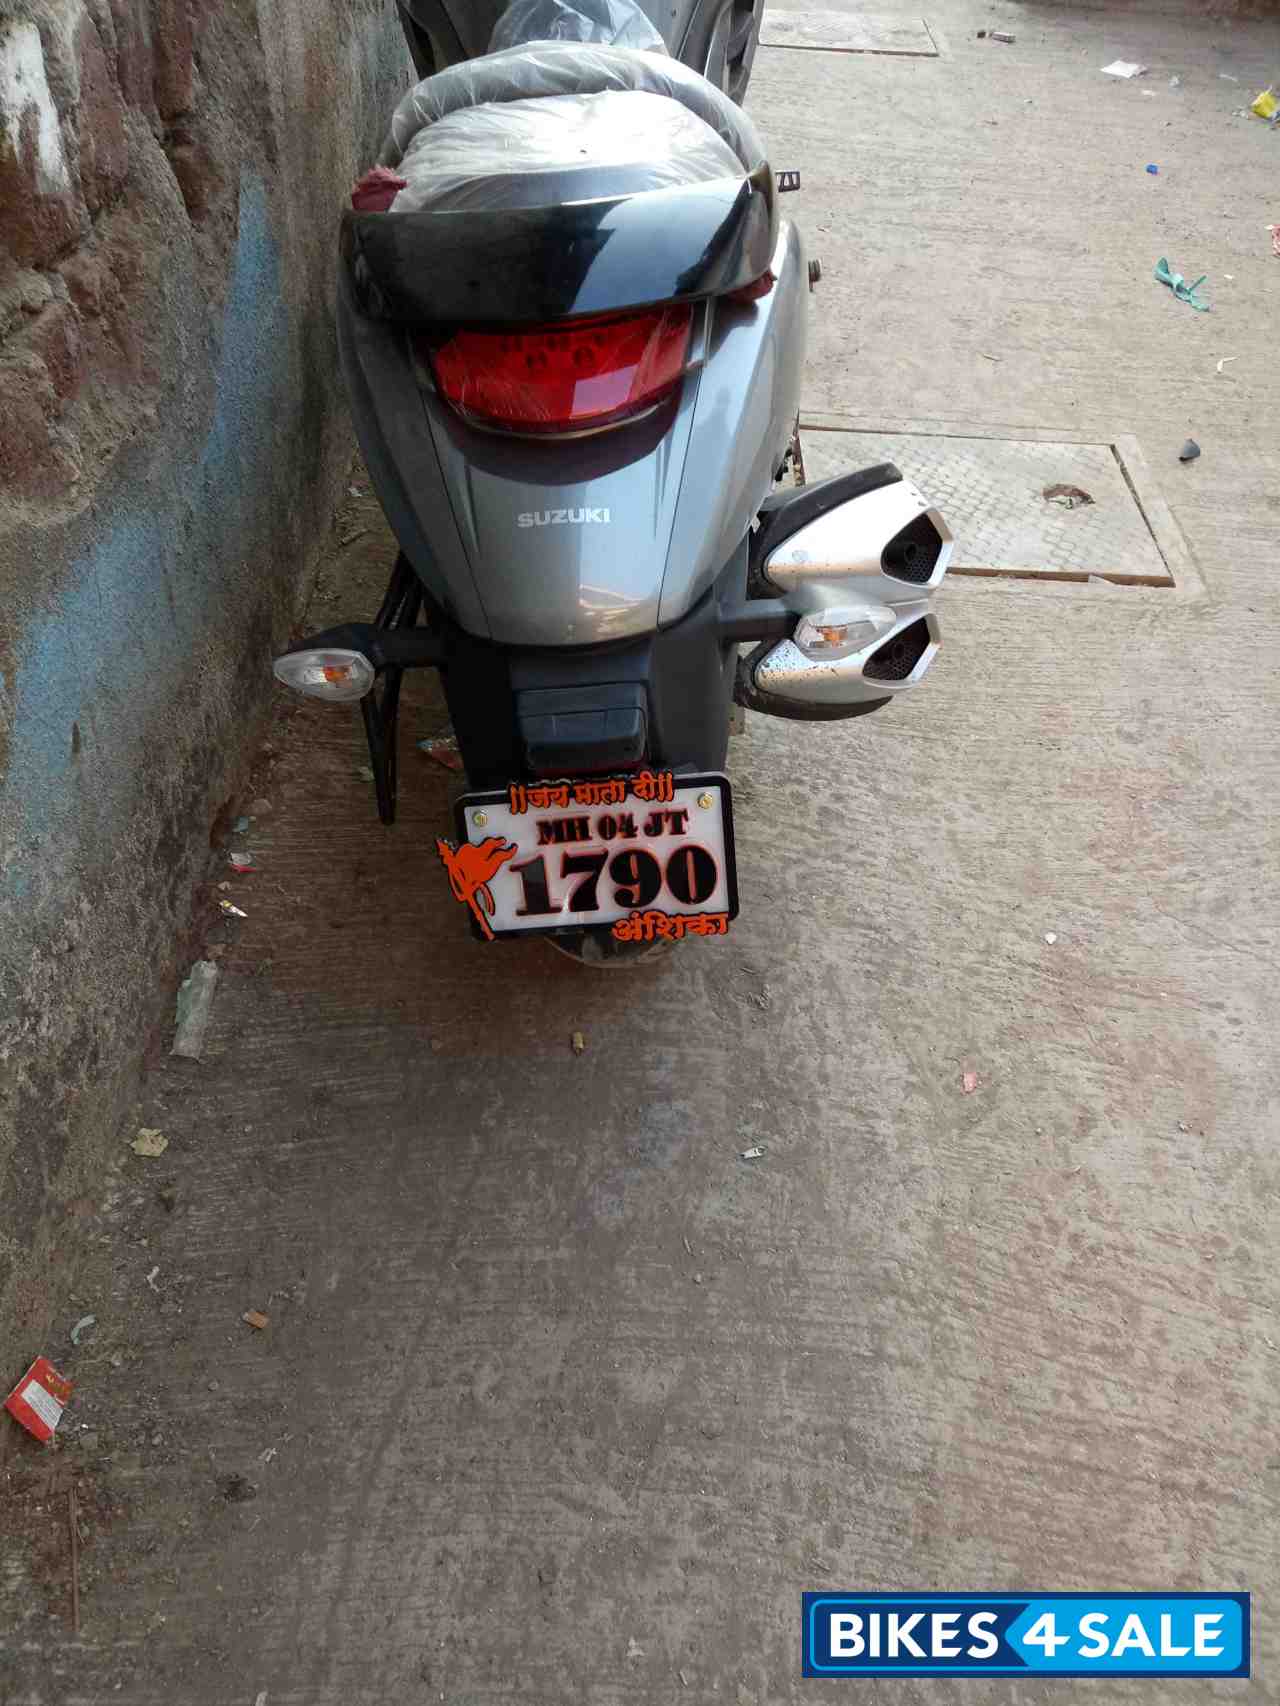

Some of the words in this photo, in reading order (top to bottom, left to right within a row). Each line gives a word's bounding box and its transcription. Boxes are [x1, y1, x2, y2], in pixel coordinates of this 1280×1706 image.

[517, 507, 611, 528] SUZUKI
[573, 777, 626, 806] माता
[536, 815, 593, 846] MH
[598, 811, 638, 841] 04
[643, 808, 688, 837] JT
[509, 844, 718, 916] 1790
